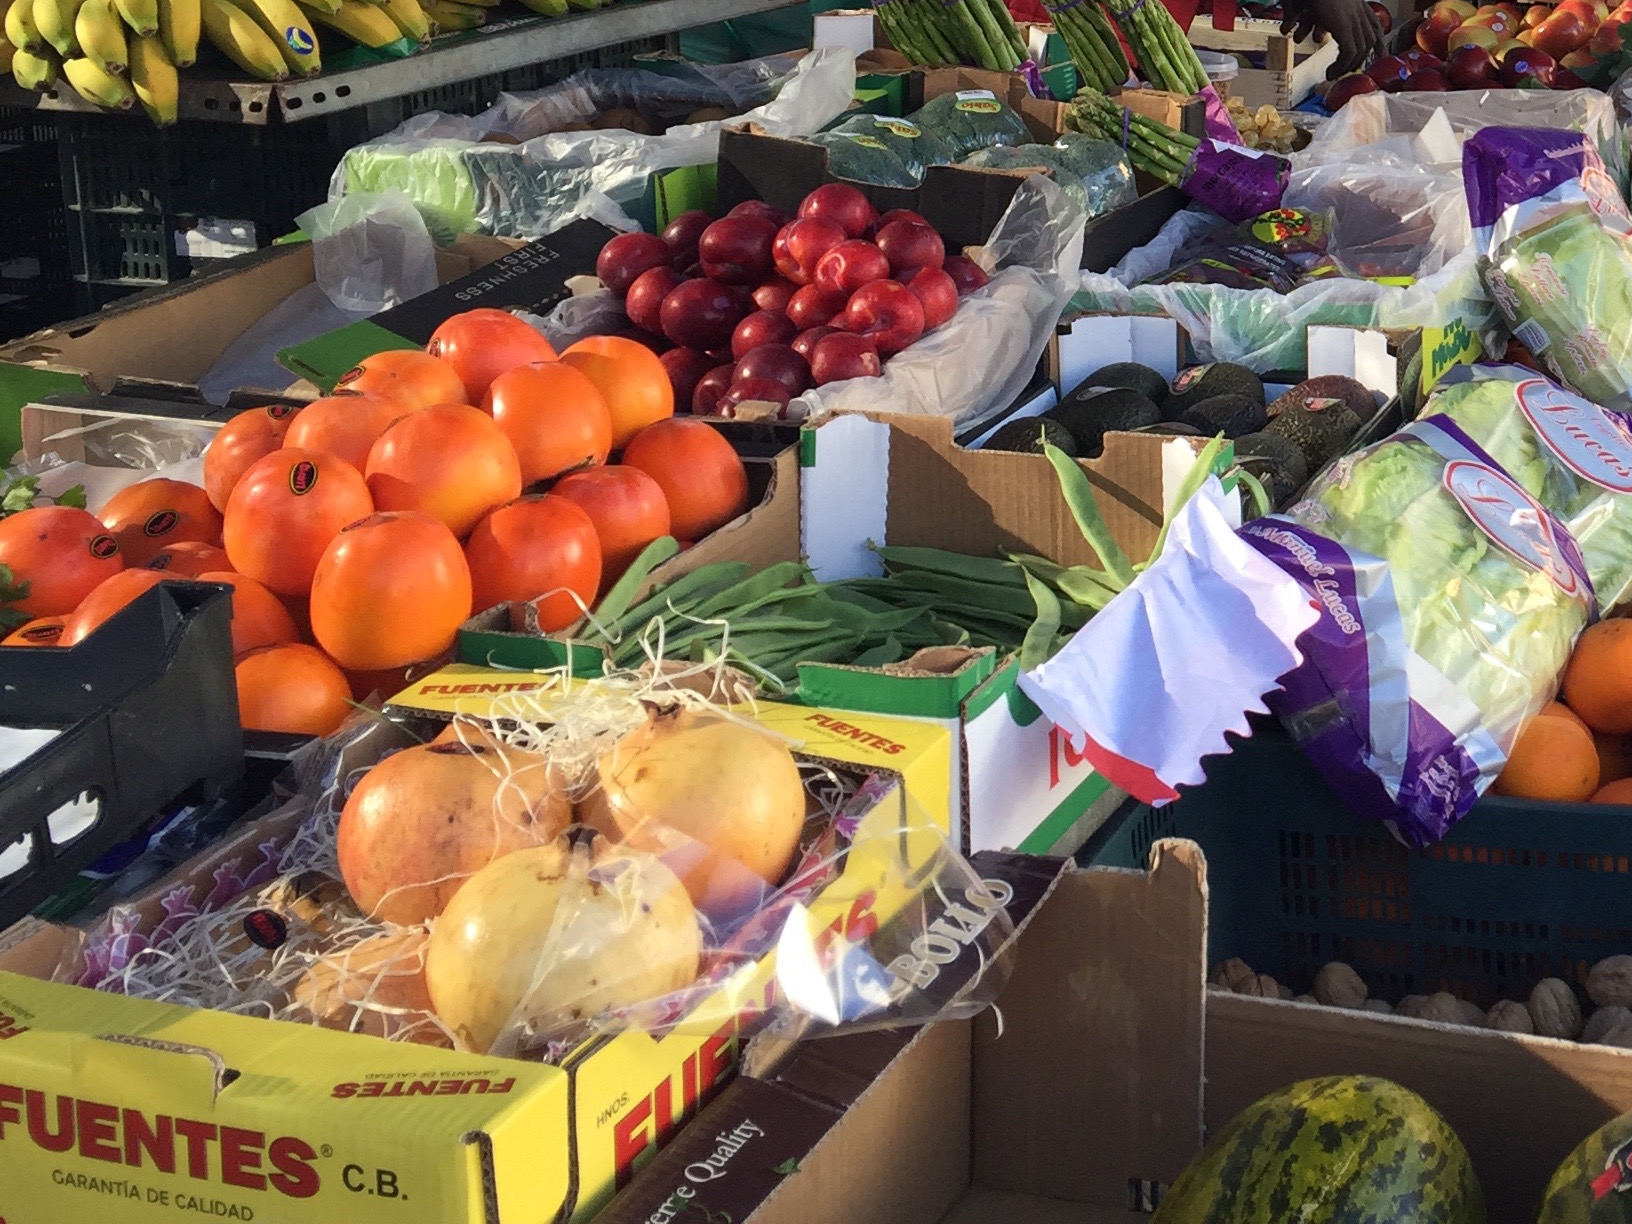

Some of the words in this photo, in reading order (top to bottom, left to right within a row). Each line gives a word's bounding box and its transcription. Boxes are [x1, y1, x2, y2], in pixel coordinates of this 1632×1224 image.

[454, 249, 560, 302] FRESHNESS
[493, 242, 547, 271] FIRST
[1312, 577, 1362, 635] Lucas
[803, 713, 907, 755] FUENTES
[330, 1076, 517, 1100] FUENTES
[0, 1082, 321, 1199] FUENTES
[684, 1118, 766, 1183] Quality
[51, 1168, 142, 1203] GARANTÍA
[146, 1187, 170, 1207] DE
[174, 1193, 254, 1222] CALIDAD
[342, 1163, 409, 1202] C.B.
